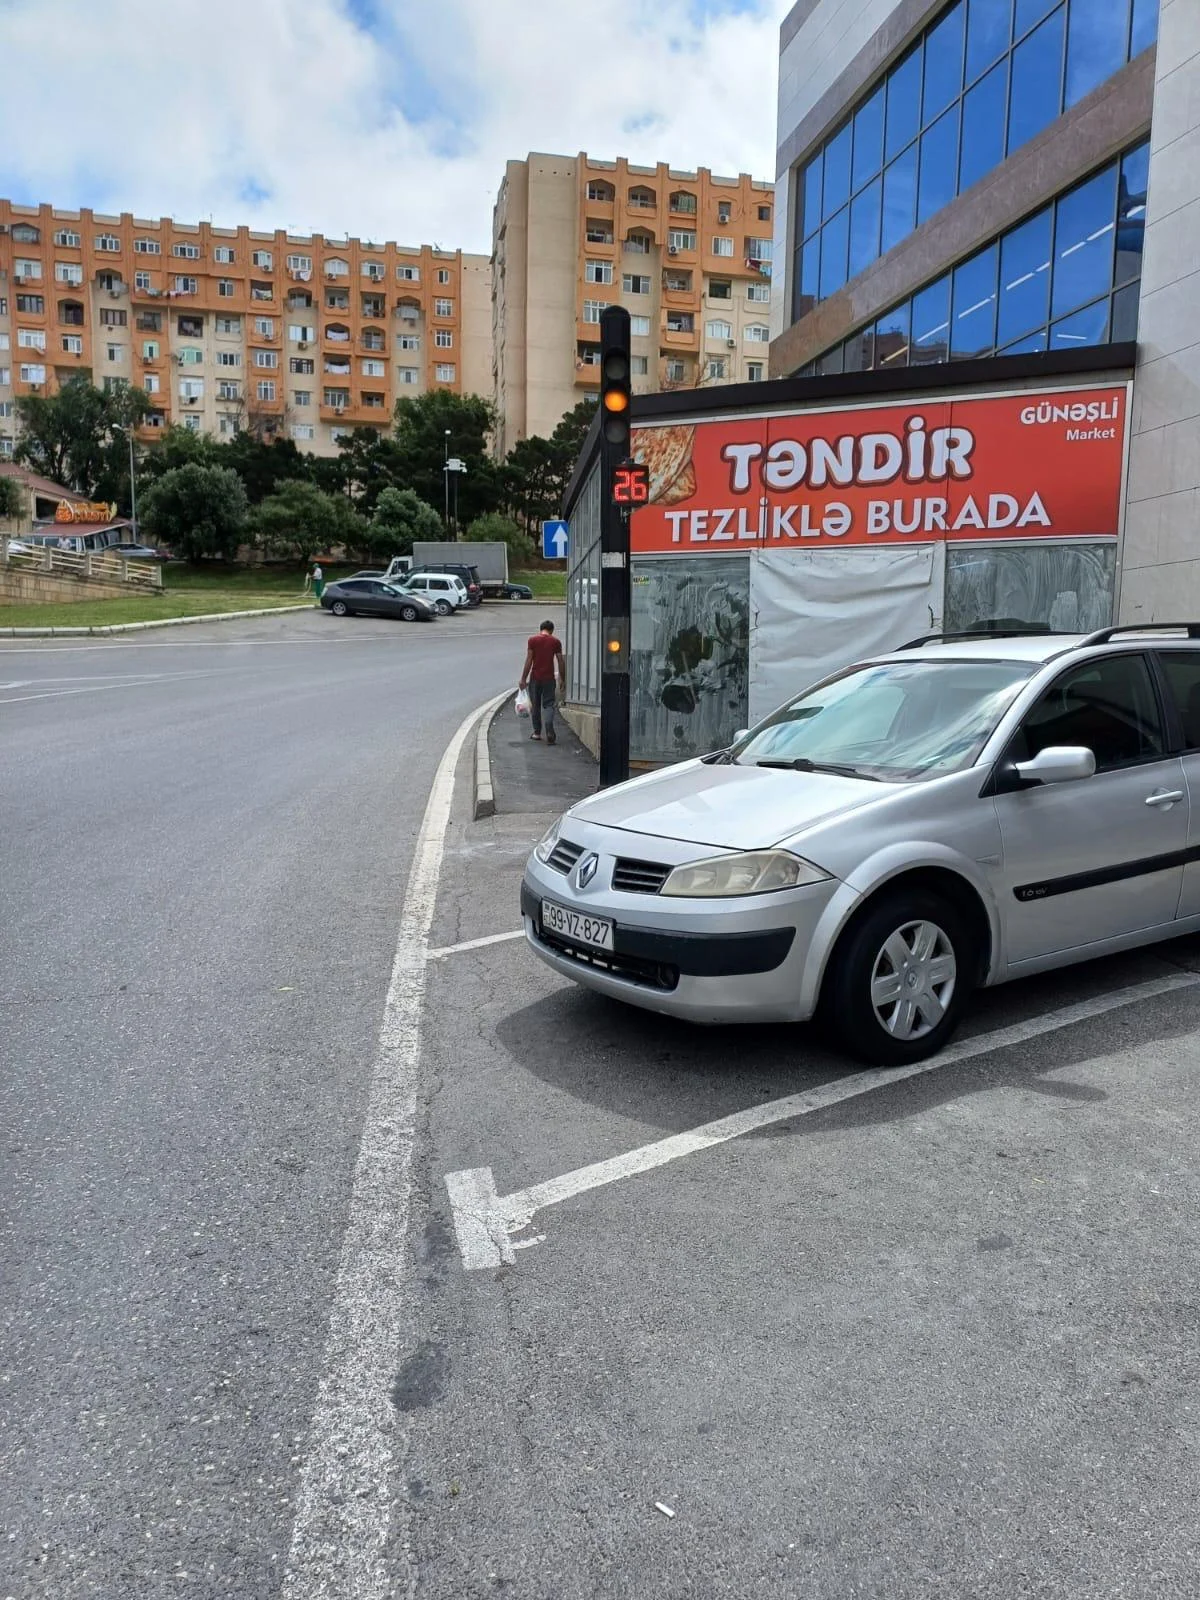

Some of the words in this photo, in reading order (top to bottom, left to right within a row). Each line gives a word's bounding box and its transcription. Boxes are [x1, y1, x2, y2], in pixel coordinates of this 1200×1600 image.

[1020, 397, 1119, 425] GÜNƏŞLİ
[1066, 427, 1116, 441] Market
[722, 415, 975, 494] TƏNDİR
[614, 471, 647, 501] 26
[664, 496, 852, 543] TEZLİKLƏ
[867, 491, 1052, 535] BURADA
